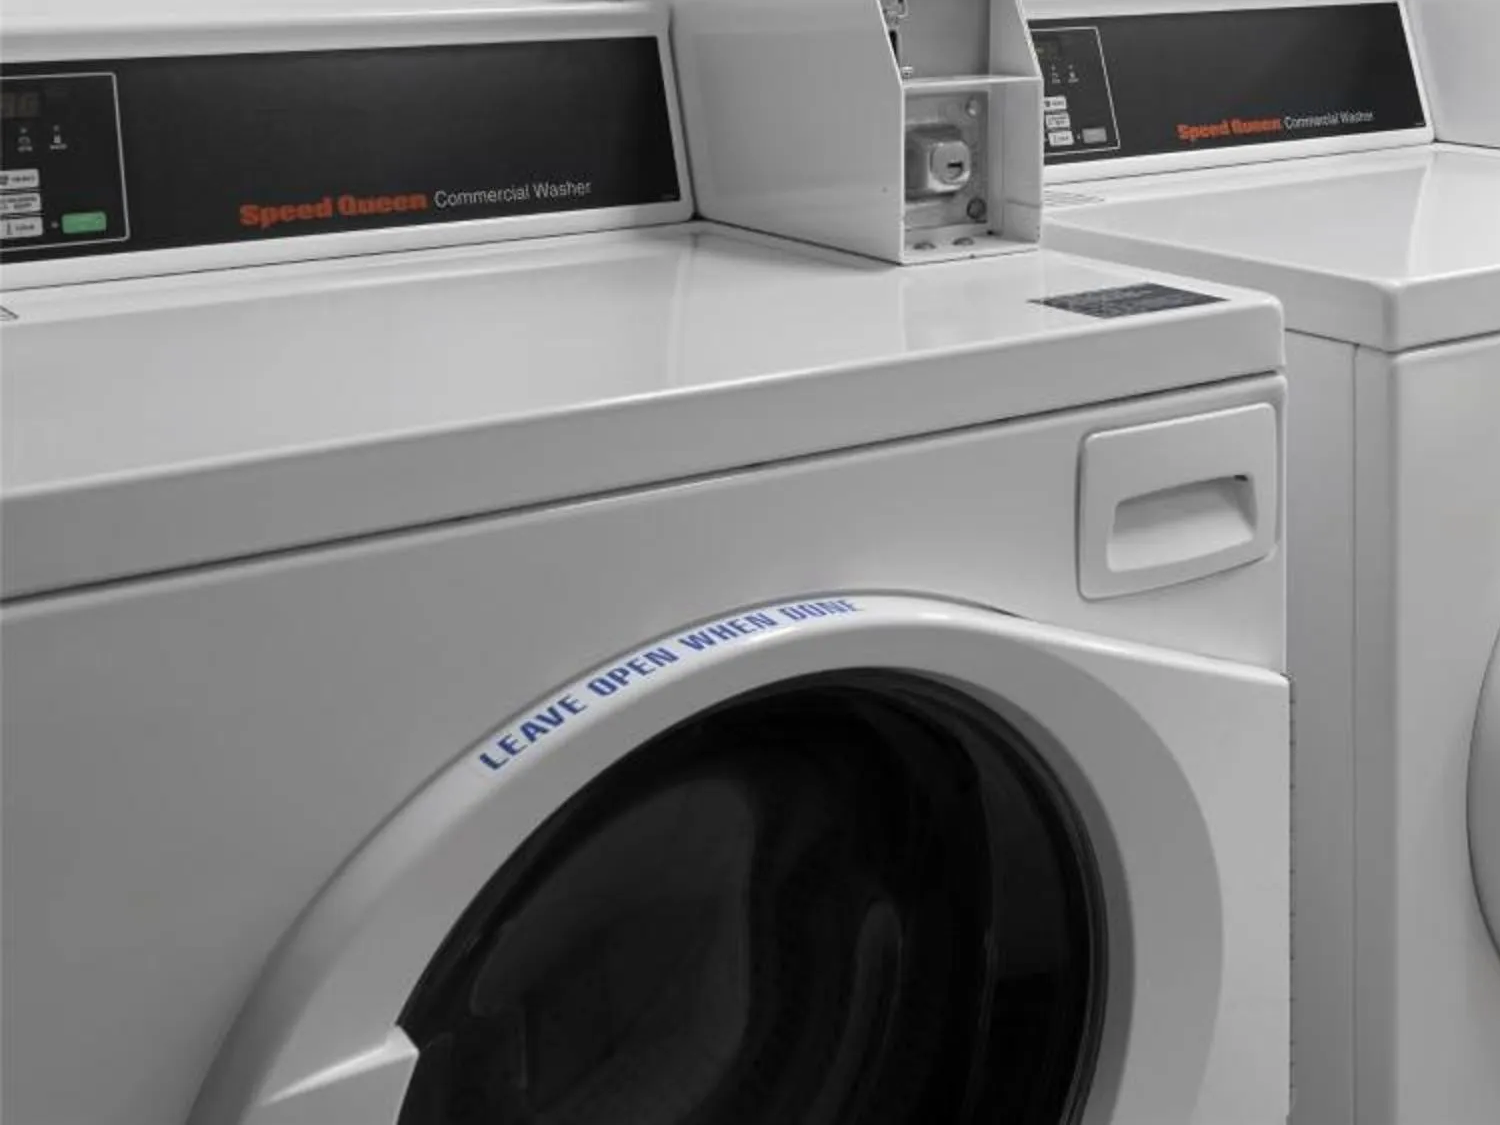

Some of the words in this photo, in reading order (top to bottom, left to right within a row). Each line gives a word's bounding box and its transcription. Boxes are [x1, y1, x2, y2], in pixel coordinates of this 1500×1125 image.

[239, 197, 333, 228] Speed
[337, 192, 428, 216] Queen
[434, 183, 530, 209] Commercial
[533, 180, 592, 199] Washer
[479, 695, 587, 770] LEAVE
[587, 647, 680, 697] OPEN
[679, 612, 779, 651] WHEN
[779, 598, 865, 621] DONE
